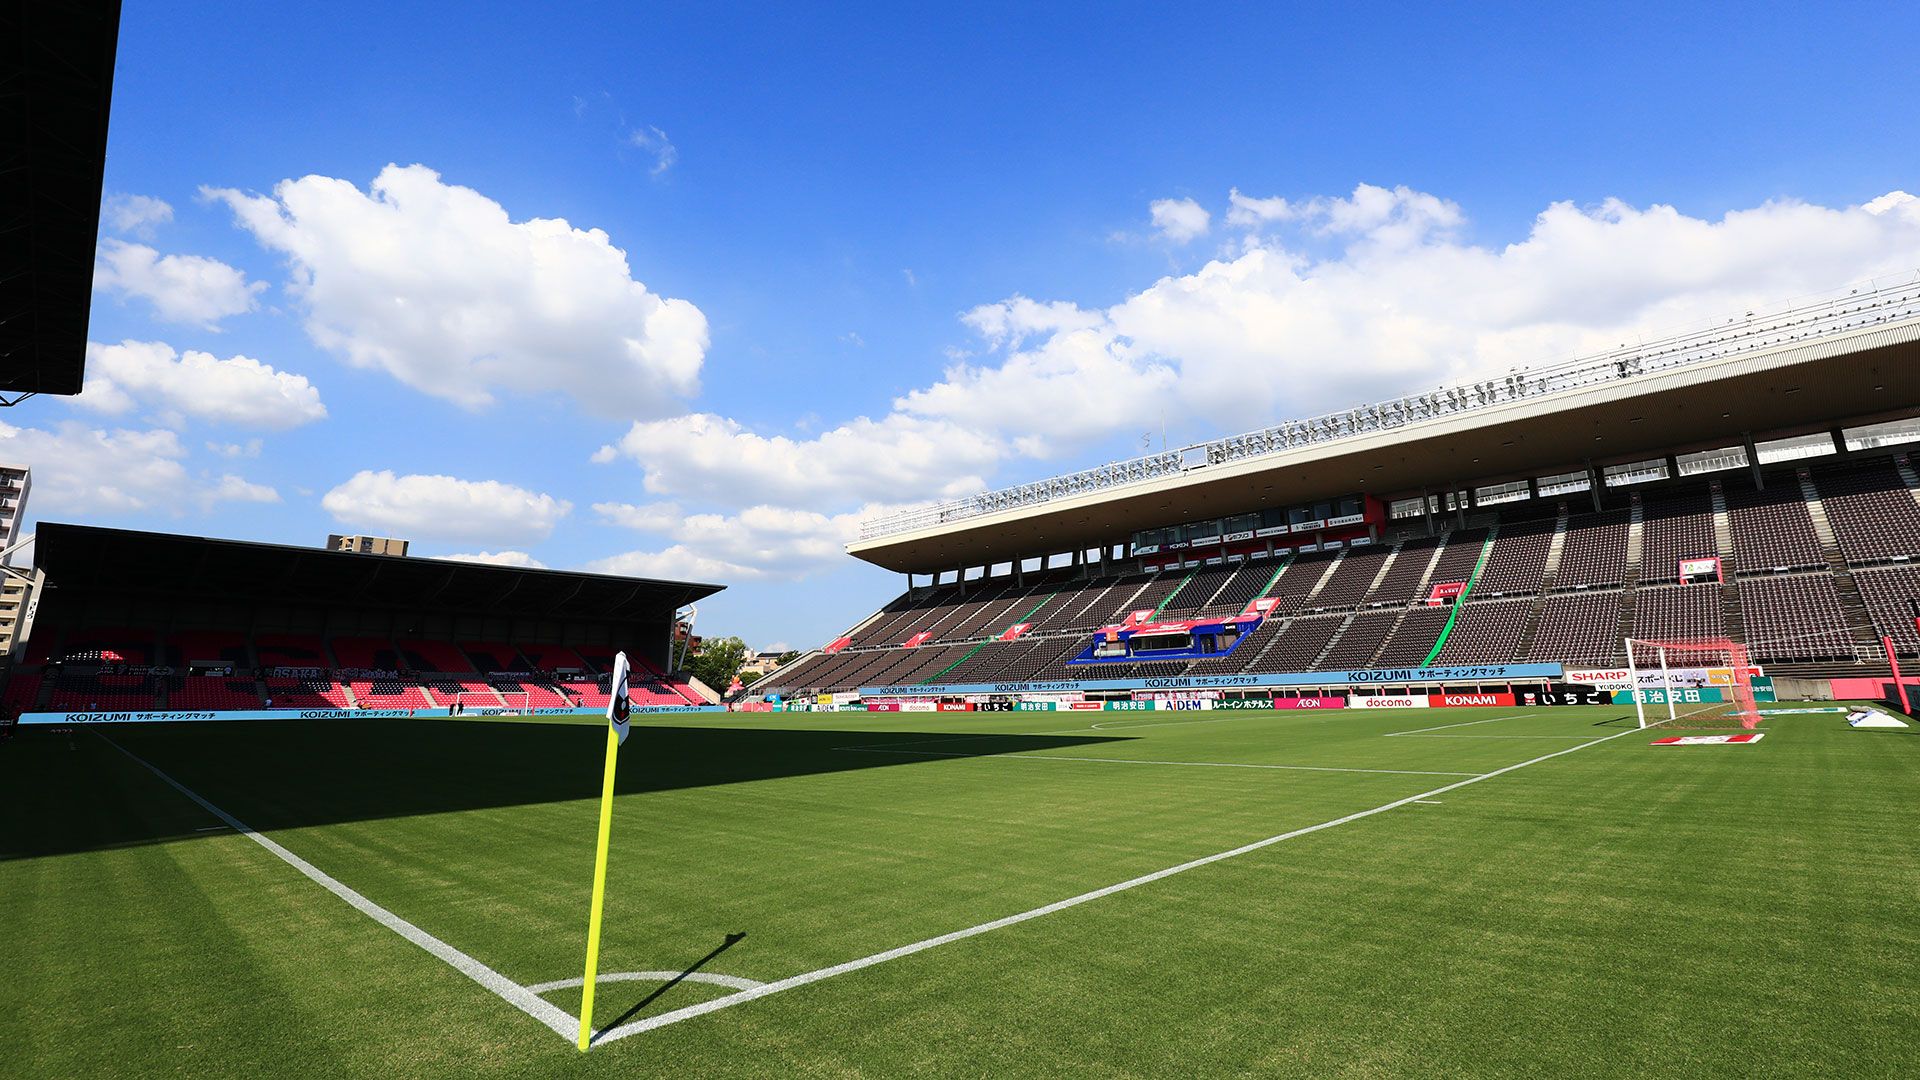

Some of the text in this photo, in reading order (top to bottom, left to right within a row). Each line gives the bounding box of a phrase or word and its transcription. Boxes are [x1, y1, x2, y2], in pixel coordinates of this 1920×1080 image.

[1349, 667, 1506, 681] KOIZUMI サポーティングマッチ
[1572, 671, 1627, 681] SHARP
[1033, 682, 1079, 690] サポーティングマッチ
[1145, 676, 1258, 688] KOIZUMI サポーティングマッチ
[1445, 694, 1497, 705] KONAMI
[1543, 692, 1600, 705] いちご
[1631, 690, 1700, 703] 明治安田
[943, 703, 966, 711] KONAMI
[984, 703, 1008, 711] いちご
[1020, 702, 1048, 711] 明治安田
[1113, 701, 1145, 710] 明治安田
[1366, 697, 1412, 707] docomo
[66, 712, 216, 722] KOIZUMI サポーティングマッチ
[299, 709, 415, 719] KOIZUMI サポーティングマッチ
